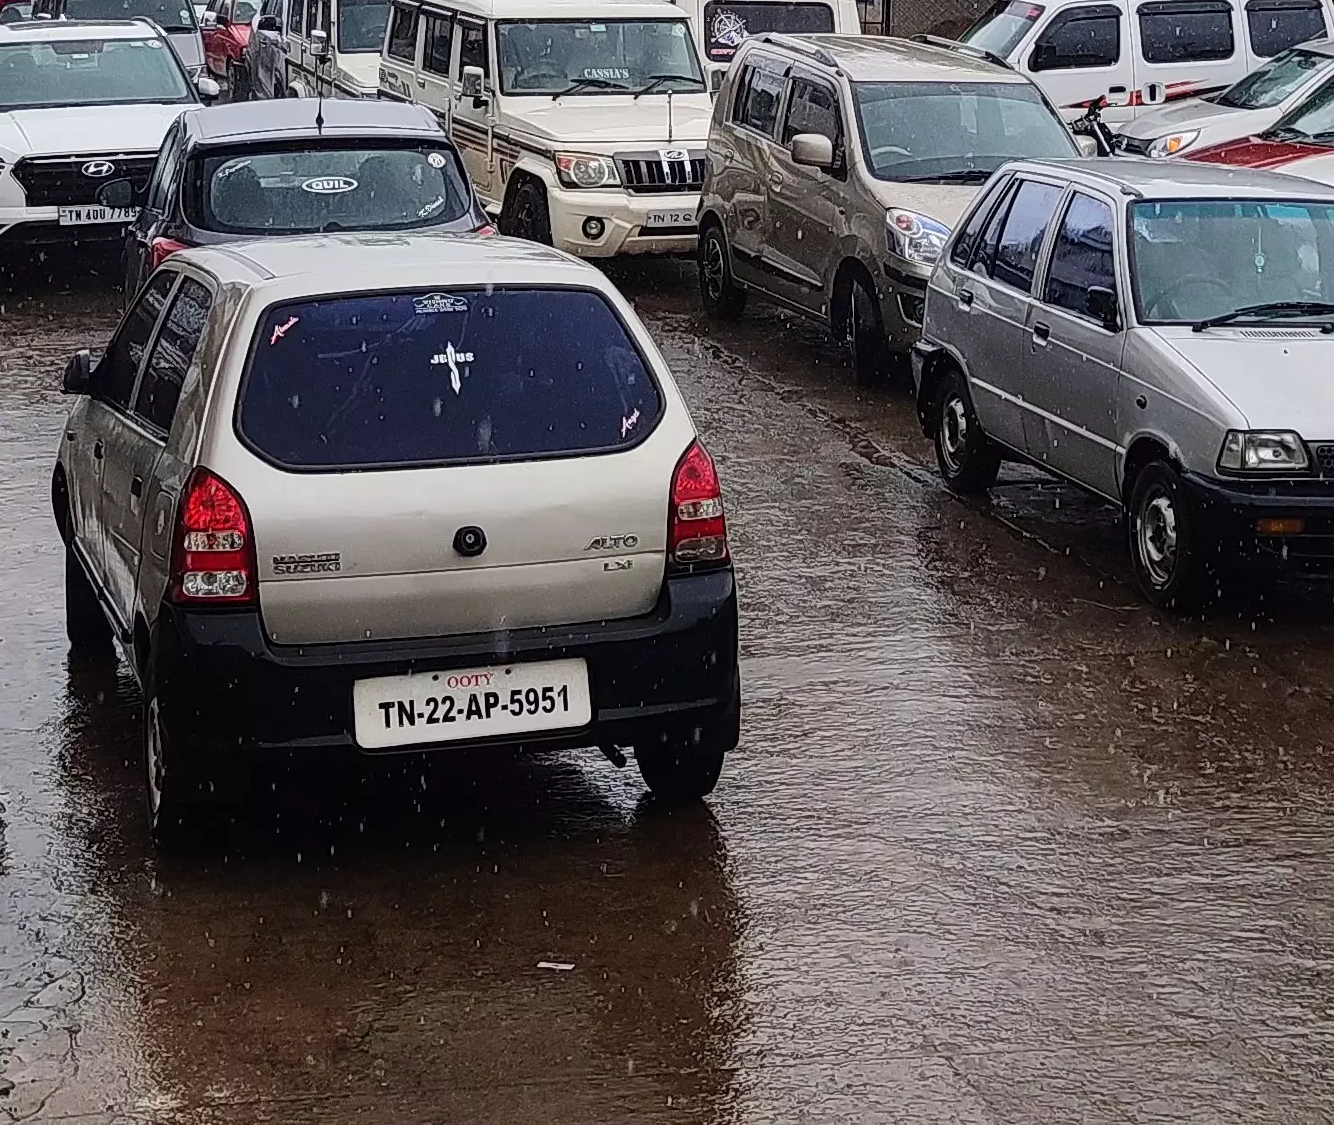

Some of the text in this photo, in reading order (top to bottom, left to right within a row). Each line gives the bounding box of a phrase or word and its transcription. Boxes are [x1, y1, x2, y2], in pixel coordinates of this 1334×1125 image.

[584, 68, 630, 79] CASSIA'S
[311, 181, 350, 190] QUIL
[653, 214, 665, 223] TN
[670, 213, 680, 222] 12
[584, 534, 638, 551] ALTO
[447, 674, 494, 689] OOTY
[378, 685, 569, 729] TN-22-AP-5951
